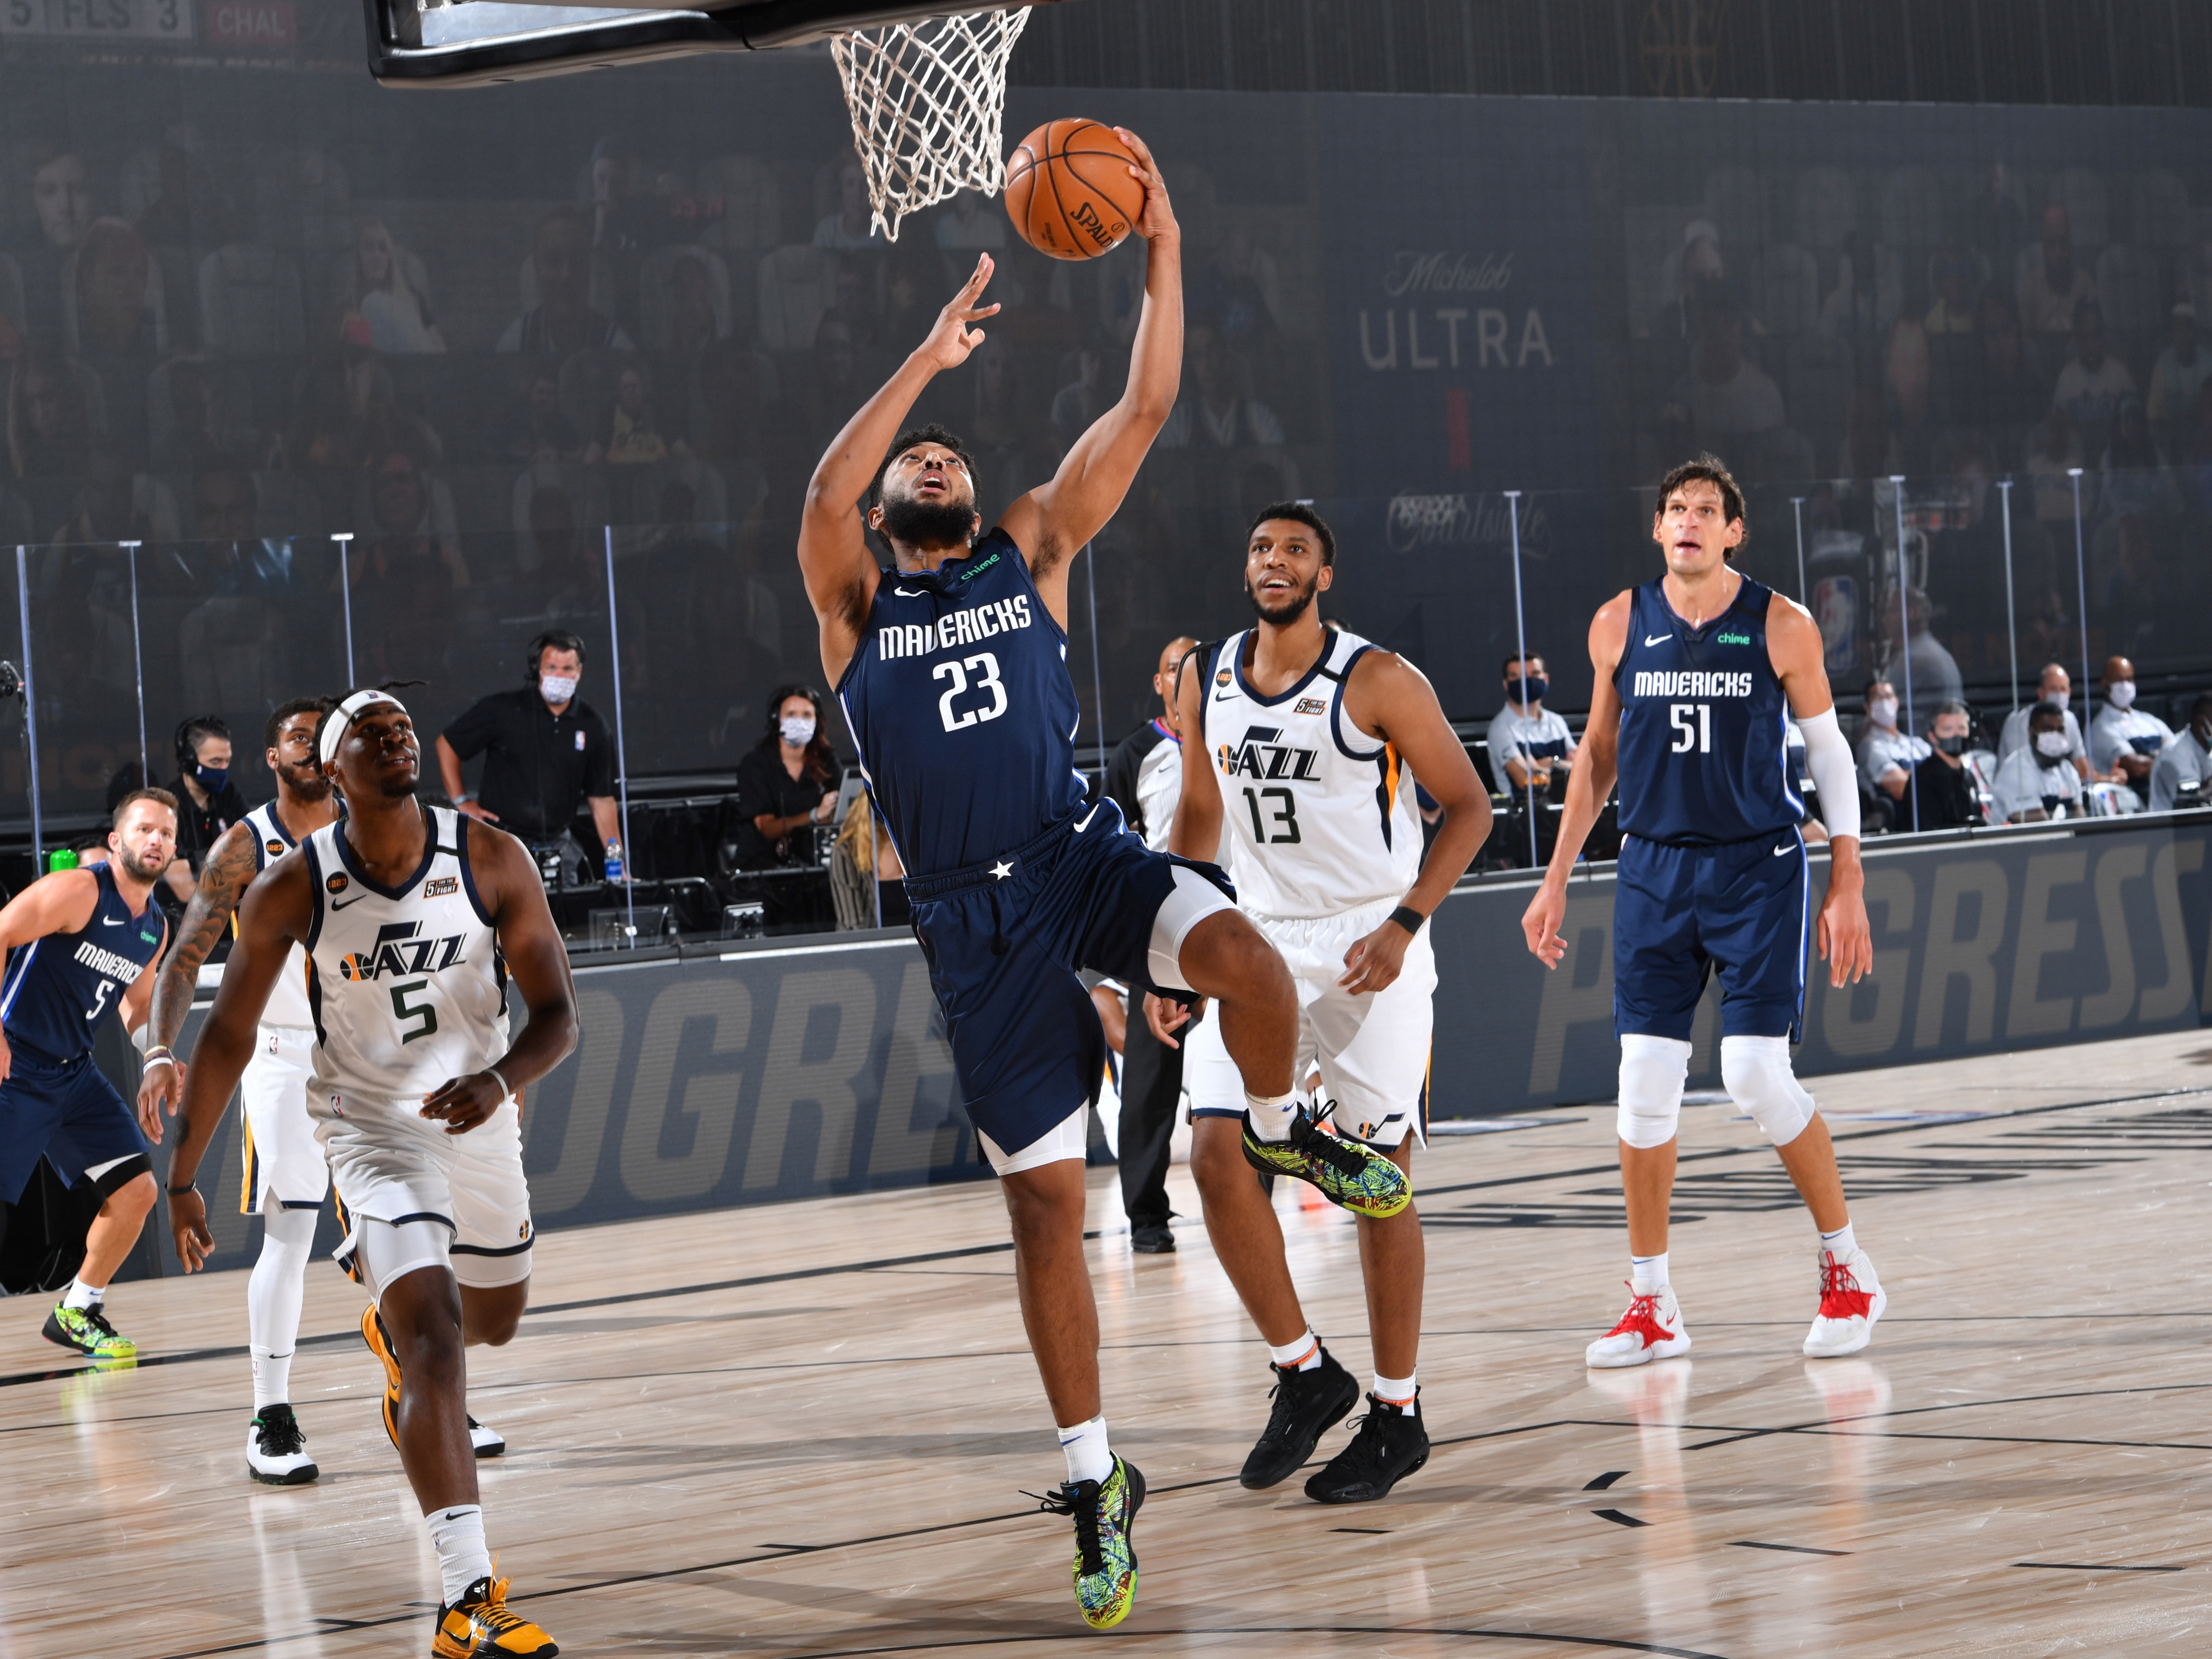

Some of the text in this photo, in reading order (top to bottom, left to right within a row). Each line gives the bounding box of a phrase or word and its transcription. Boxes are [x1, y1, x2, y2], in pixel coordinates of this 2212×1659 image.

[216, 6, 286, 37] CHAL
[1384, 251, 1515, 297] Michelob
[1359, 308, 1553, 369] ULTRA
[961, 553, 1000, 581] chime
[879, 595, 1031, 661] MAVERICKS
[1717, 632, 1750, 646] chime
[933, 653, 1007, 732] 23
[1634, 671, 1752, 698] MAVERICKS
[1296, 699, 1308, 712] 5
[1670, 704, 1711, 753] 51
[1218, 725, 1322, 781] JAZZ
[1242, 787, 1301, 844] 13
[267, 843, 284, 852] 1223
[327, 877, 347, 889] 1223
[426, 881, 435, 897] 5
[436, 885, 456, 895] FIGHT
[140, 930, 157, 945] chime
[340, 920, 467, 981] JAZZ
[85, 979, 116, 1020] 5
[390, 979, 438, 1045] 5
